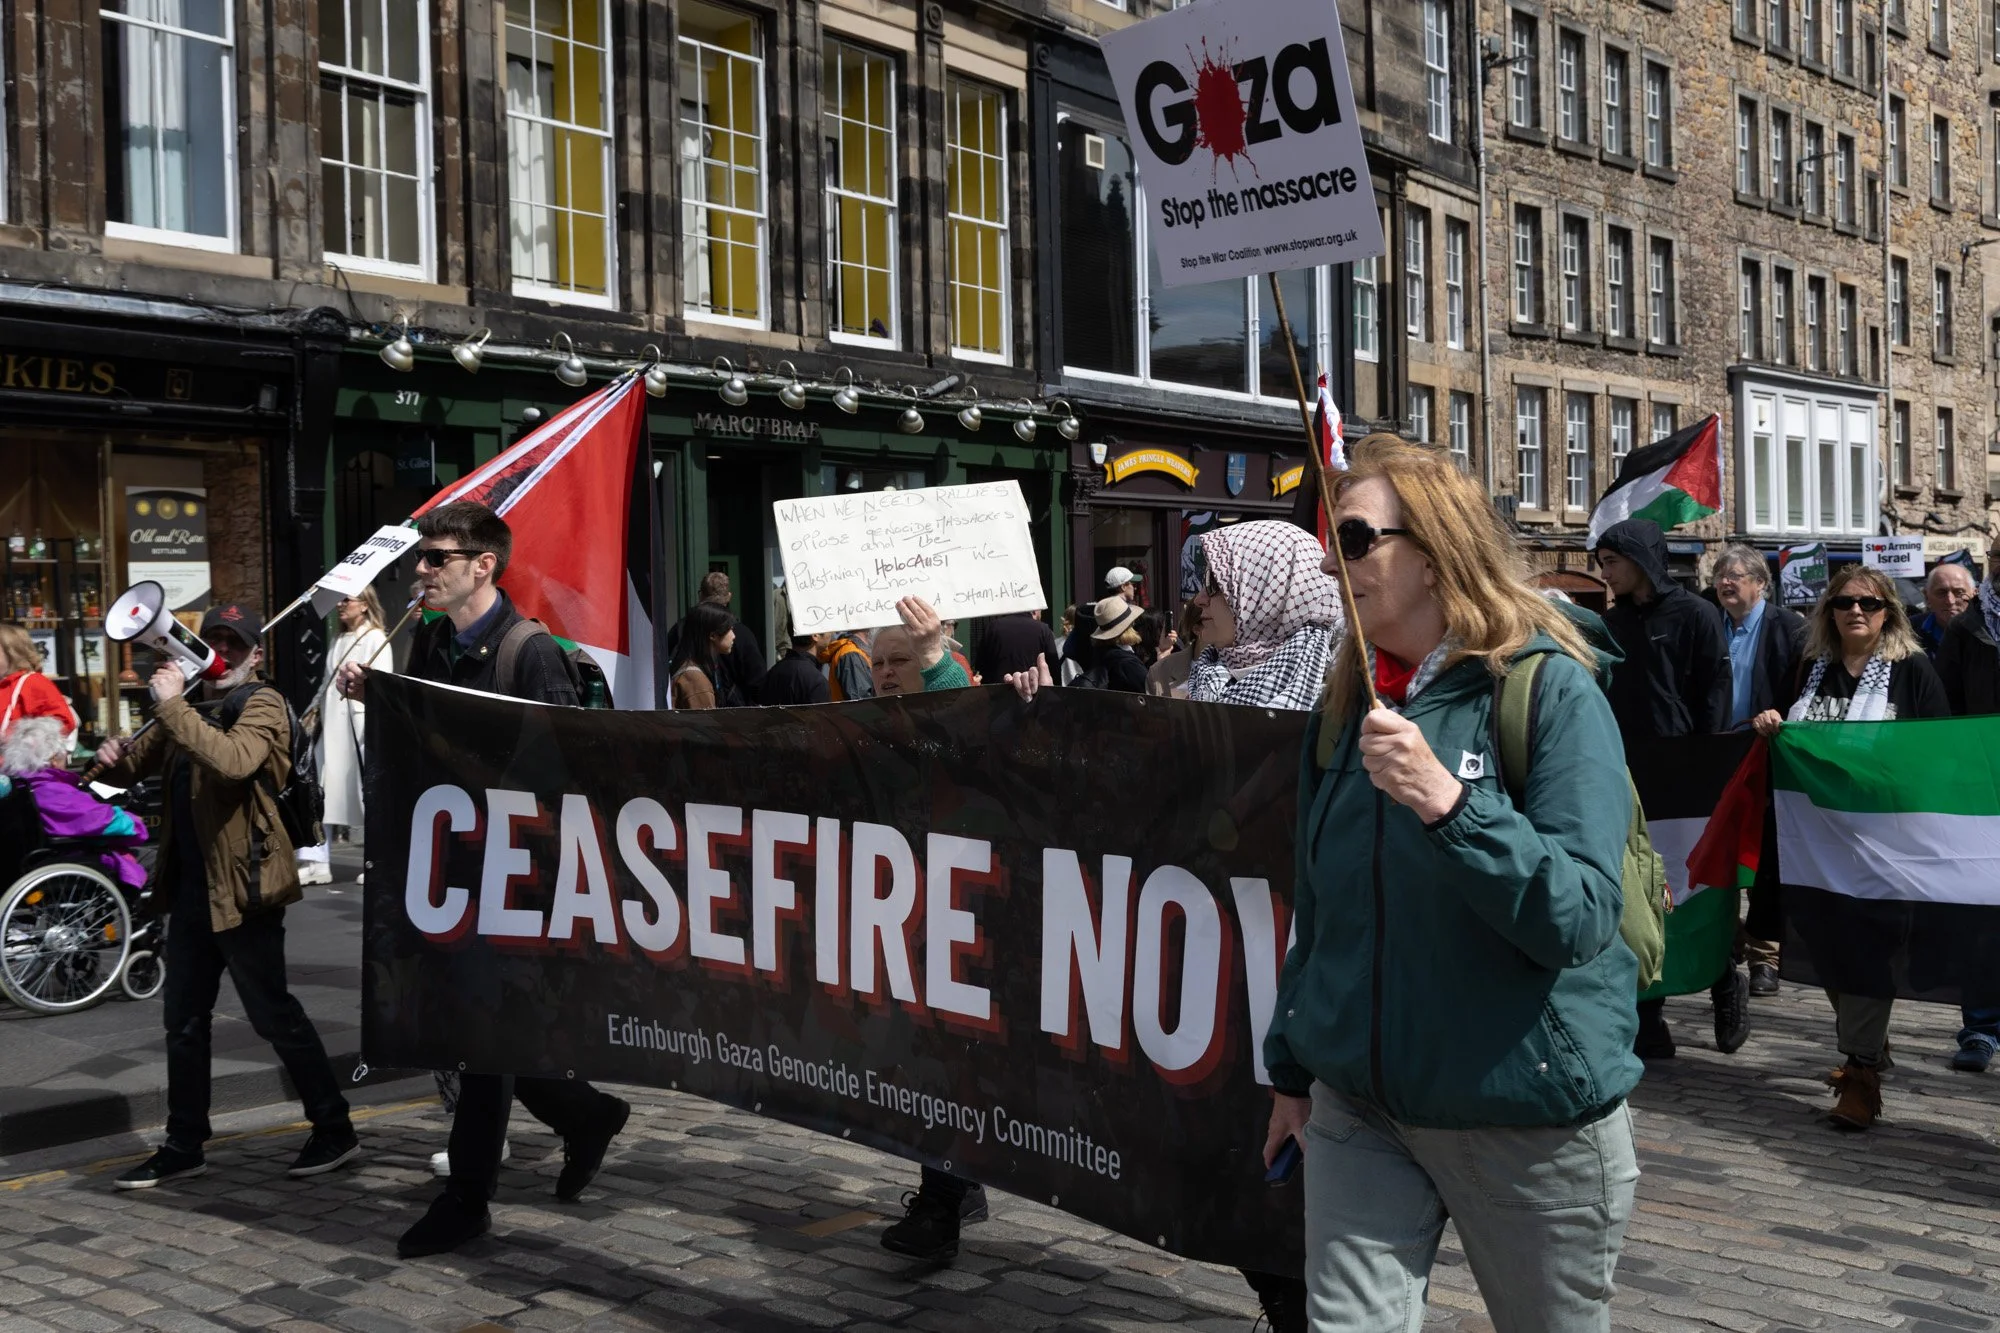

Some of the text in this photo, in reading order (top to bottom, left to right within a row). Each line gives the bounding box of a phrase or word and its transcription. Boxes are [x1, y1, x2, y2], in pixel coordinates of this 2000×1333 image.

[1135, 37, 1341, 165] Gza
[1161, 166, 1357, 229] Stop the massacre
[1180, 229, 1358, 269] Stop the War Coalition www.stopwar.org.uk
[0, 353, 117, 394] KIES
[395, 390, 420, 406] 377
[694, 412, 820, 438] MARCHBRAE
[1117, 456, 1137, 473] JAMES
[1138, 453, 1165, 464] PRINGLE
[780, 502, 826, 524] WHEN
[833, 499, 856, 517] WE
[864, 493, 925, 514] NEED
[130, 528, 157, 544] Old
[155, 529, 175, 543] and
[363, 536, 408, 553] rming
[1888, 541, 1921, 551] Arming
[1878, 552, 1910, 564] Israel
[803, 598, 899, 626] DEMOCRAC
[404, 783, 994, 1024] CEASEFIRE
[607, 1013, 1121, 1180] Edinburgh Gaza Genocide Emergency Committee
